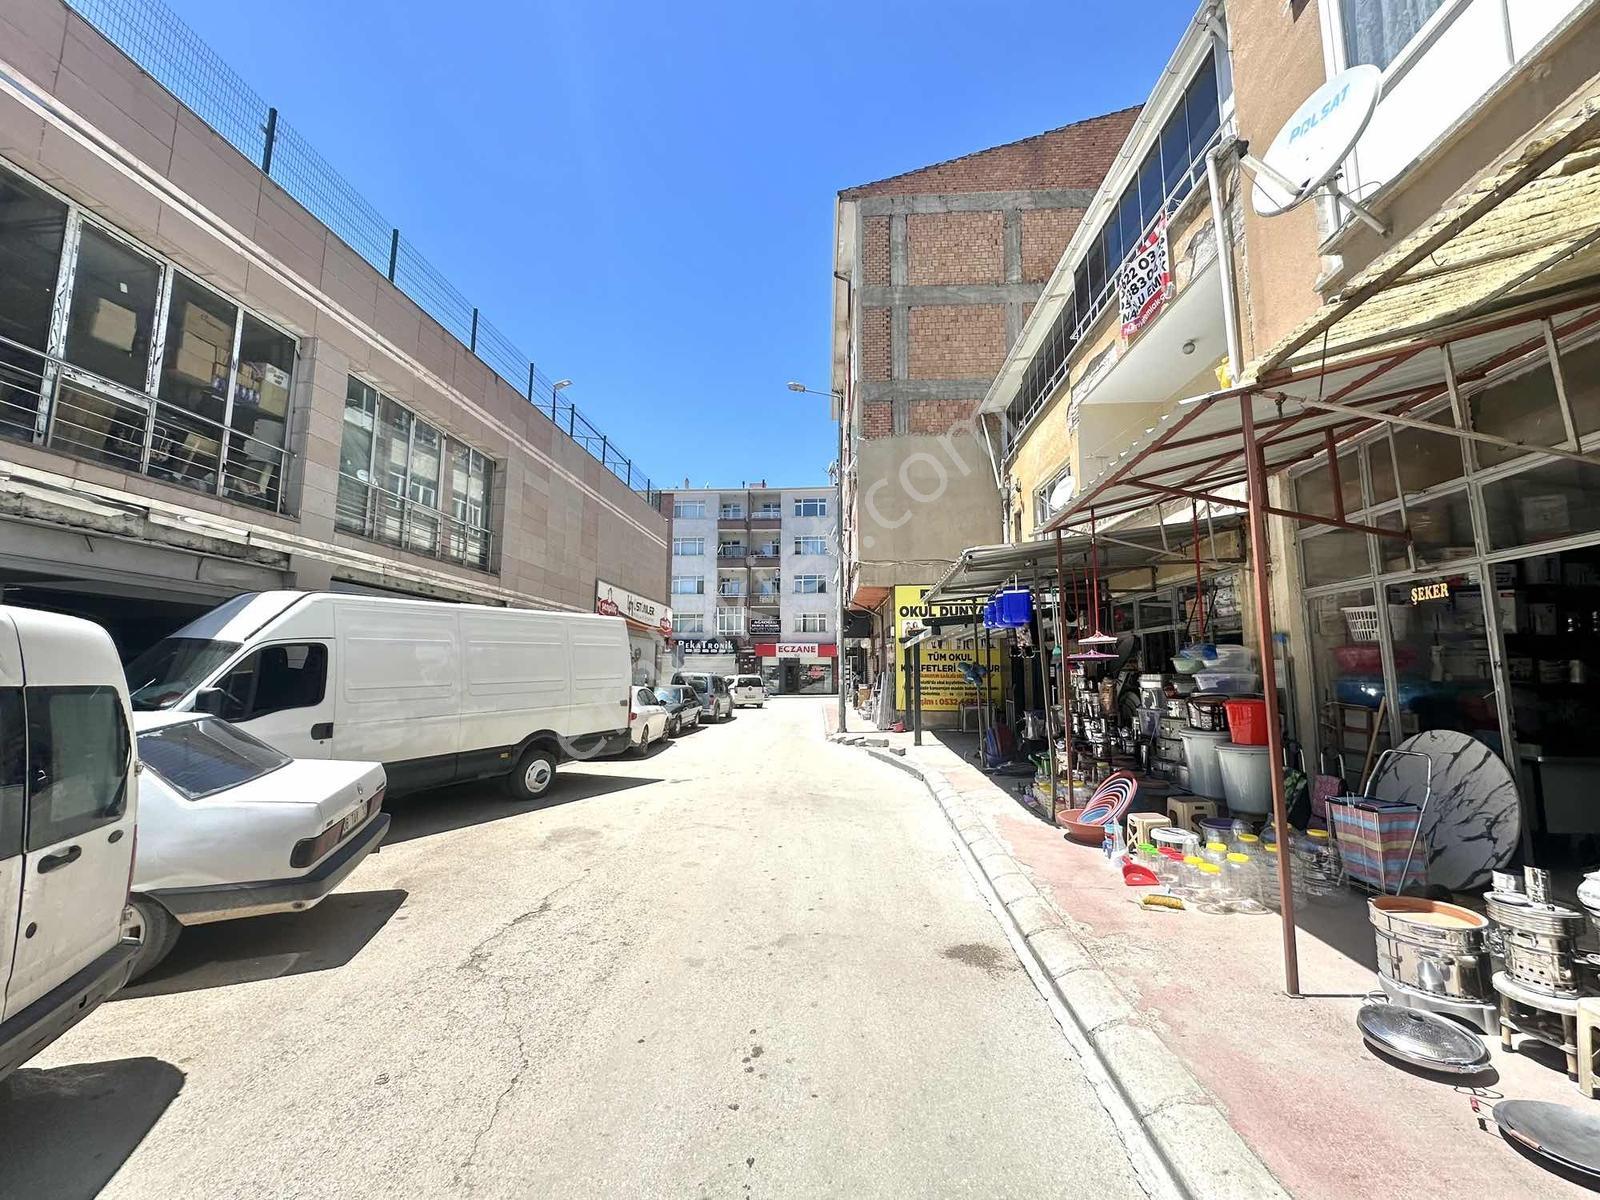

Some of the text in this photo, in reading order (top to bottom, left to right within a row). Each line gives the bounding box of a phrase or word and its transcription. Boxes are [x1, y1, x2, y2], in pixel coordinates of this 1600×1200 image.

[1410, 582, 1450, 606] ŞEKER
[899, 605, 936, 618] OKUL
[778, 645, 817, 654] ECZANE
[928, 651, 973, 661] TÜM OKUL
